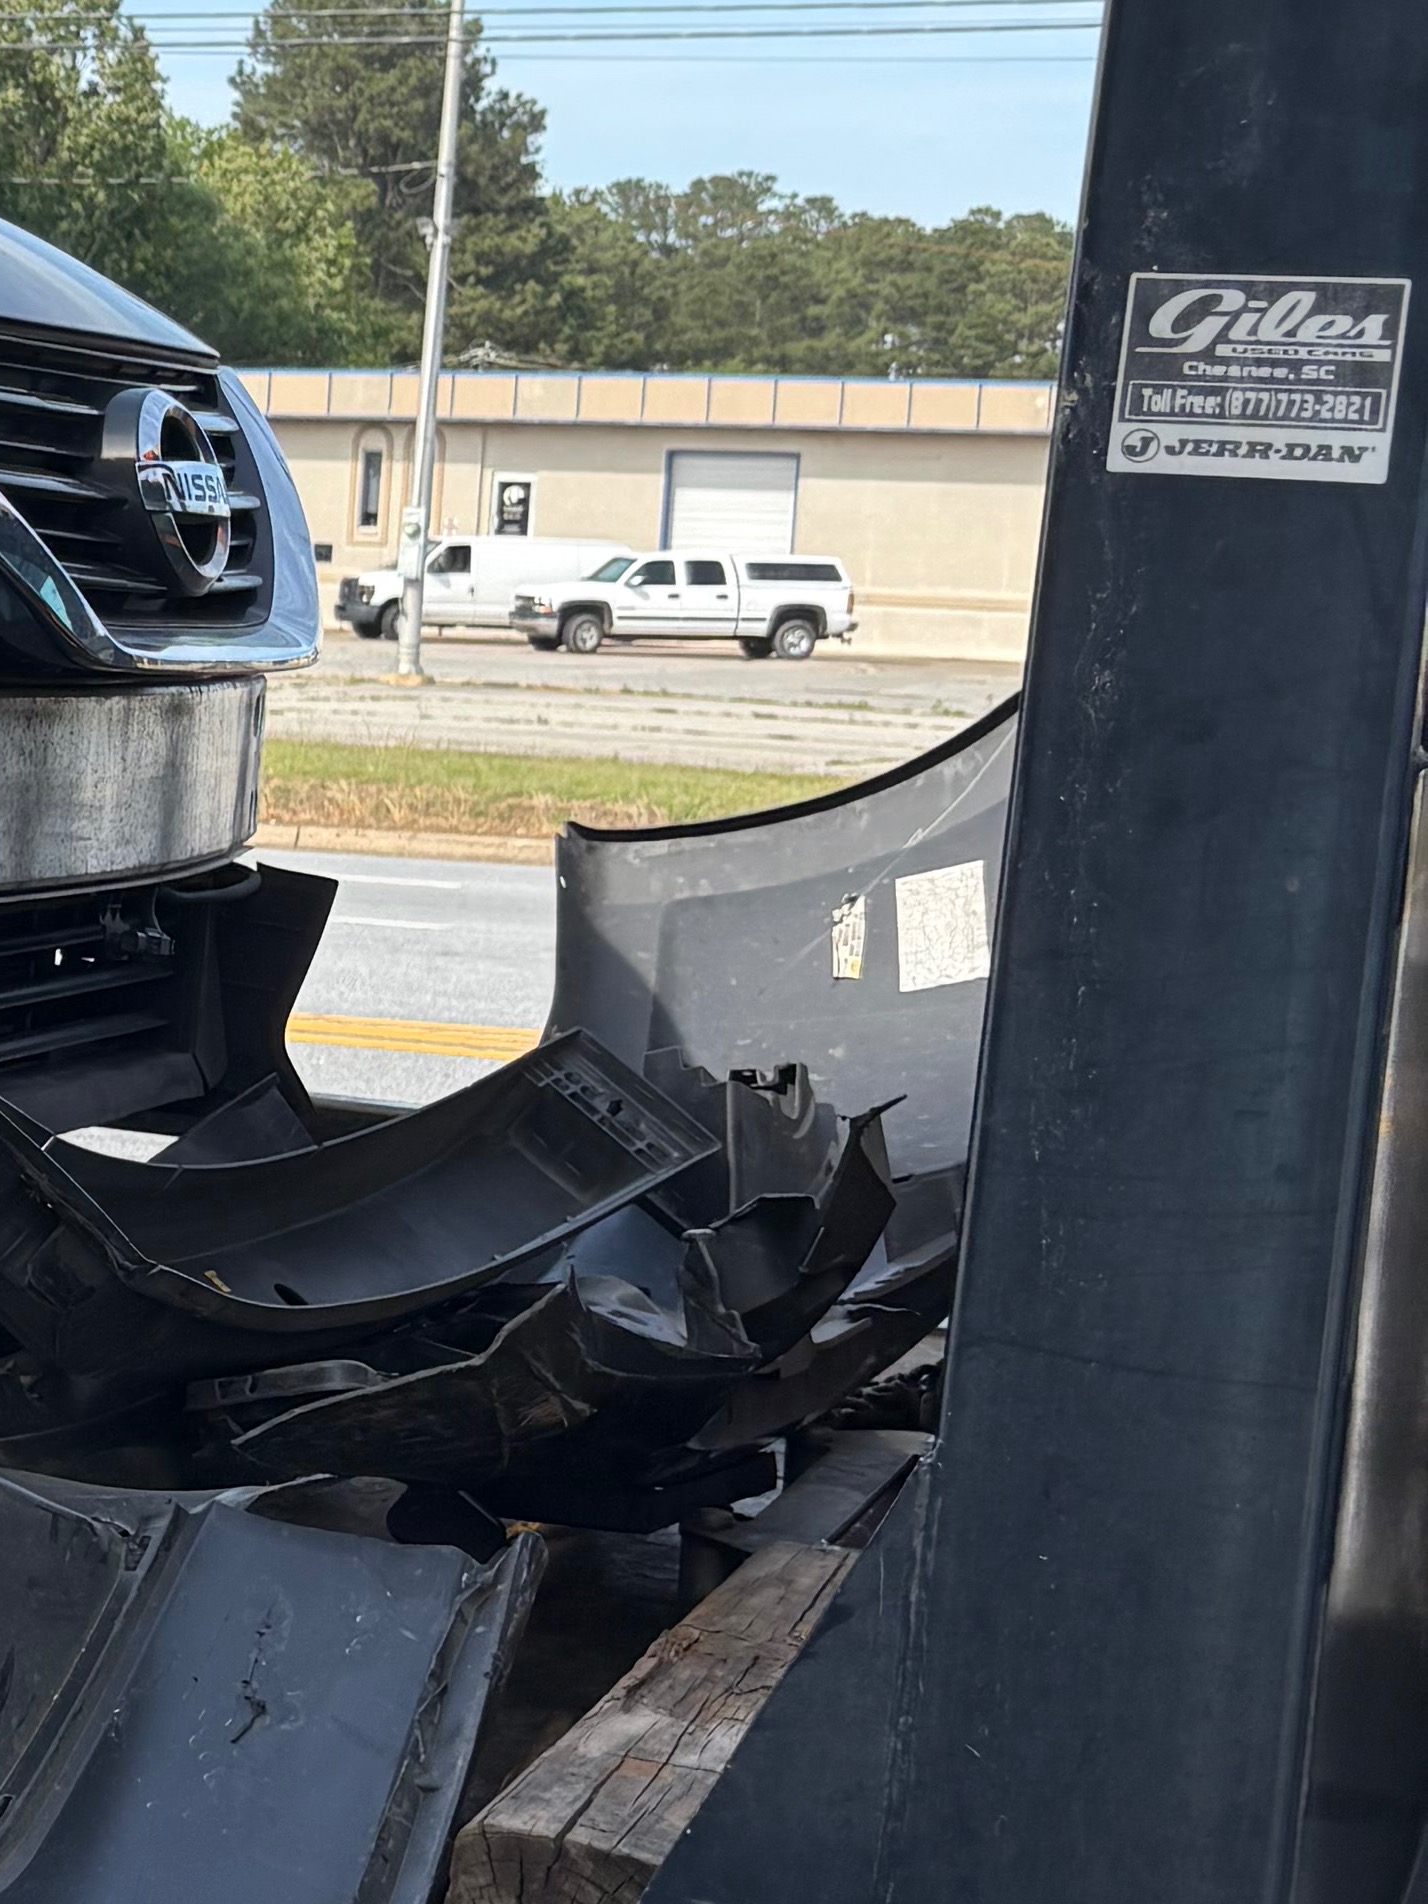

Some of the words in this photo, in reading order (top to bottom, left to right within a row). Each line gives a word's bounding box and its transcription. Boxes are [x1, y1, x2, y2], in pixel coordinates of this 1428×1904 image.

[1134, 288, 1394, 353] Giles
[1182, 361, 1295, 380] Chesnee,
[1300, 365, 1336, 380] SC
[1142, 388, 1172, 413] Toll
[1174, 388, 1221, 415] Free:
[1225, 389, 1370, 421] (877)773-2821
[161, 472, 230, 504] NISSA
